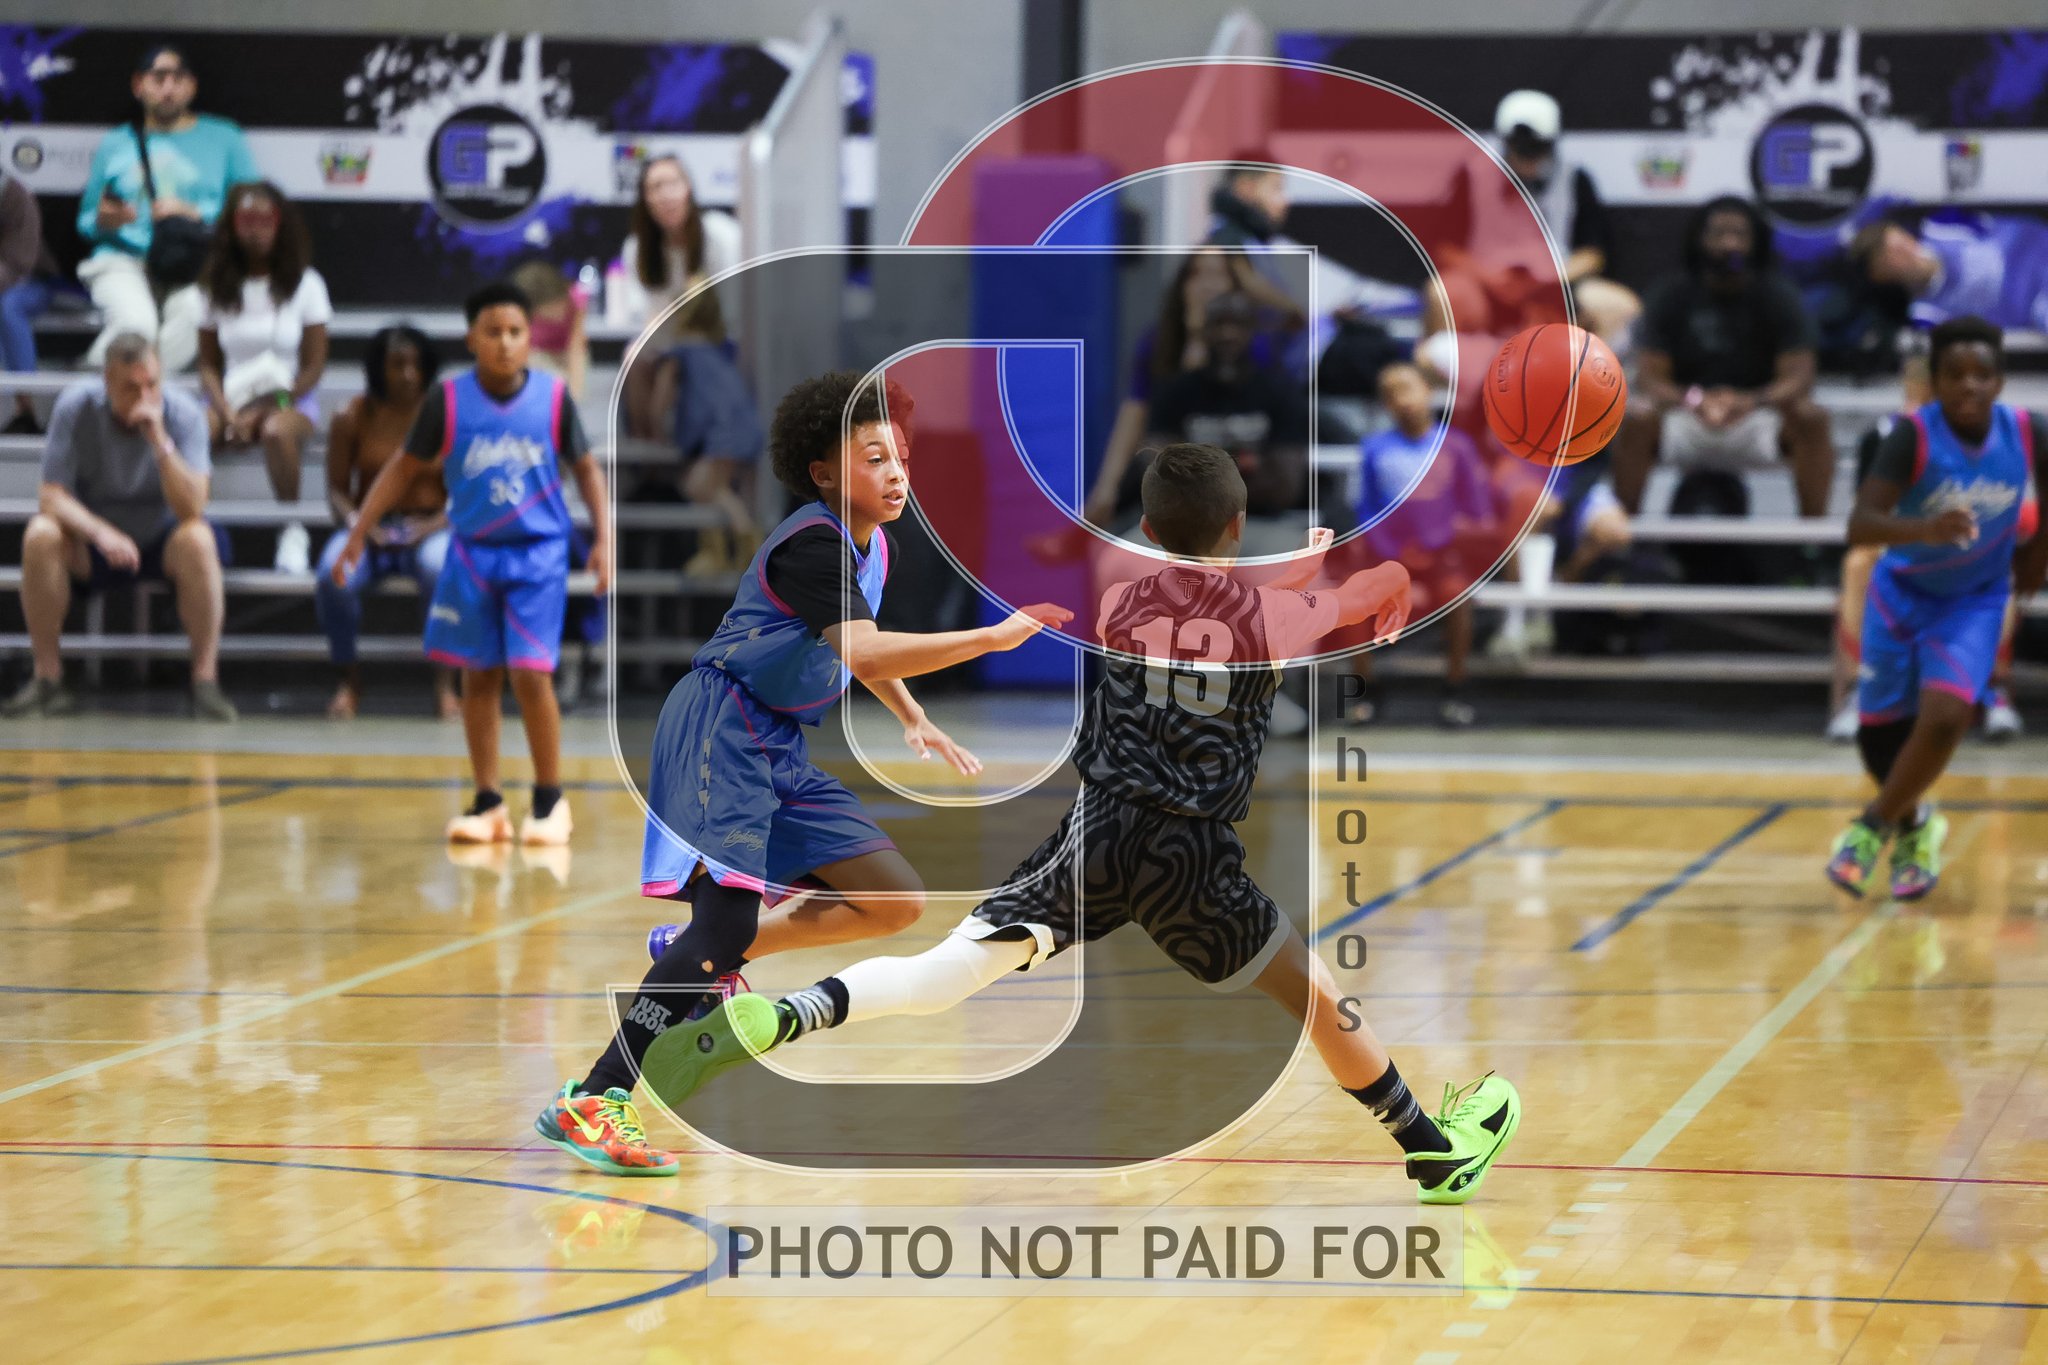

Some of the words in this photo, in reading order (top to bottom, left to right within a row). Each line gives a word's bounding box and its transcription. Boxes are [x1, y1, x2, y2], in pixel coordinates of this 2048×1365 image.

[1130, 615, 1234, 717] 13
[625, 1006, 668, 1036] HOOP
[634, 996, 673, 1023] JUST
